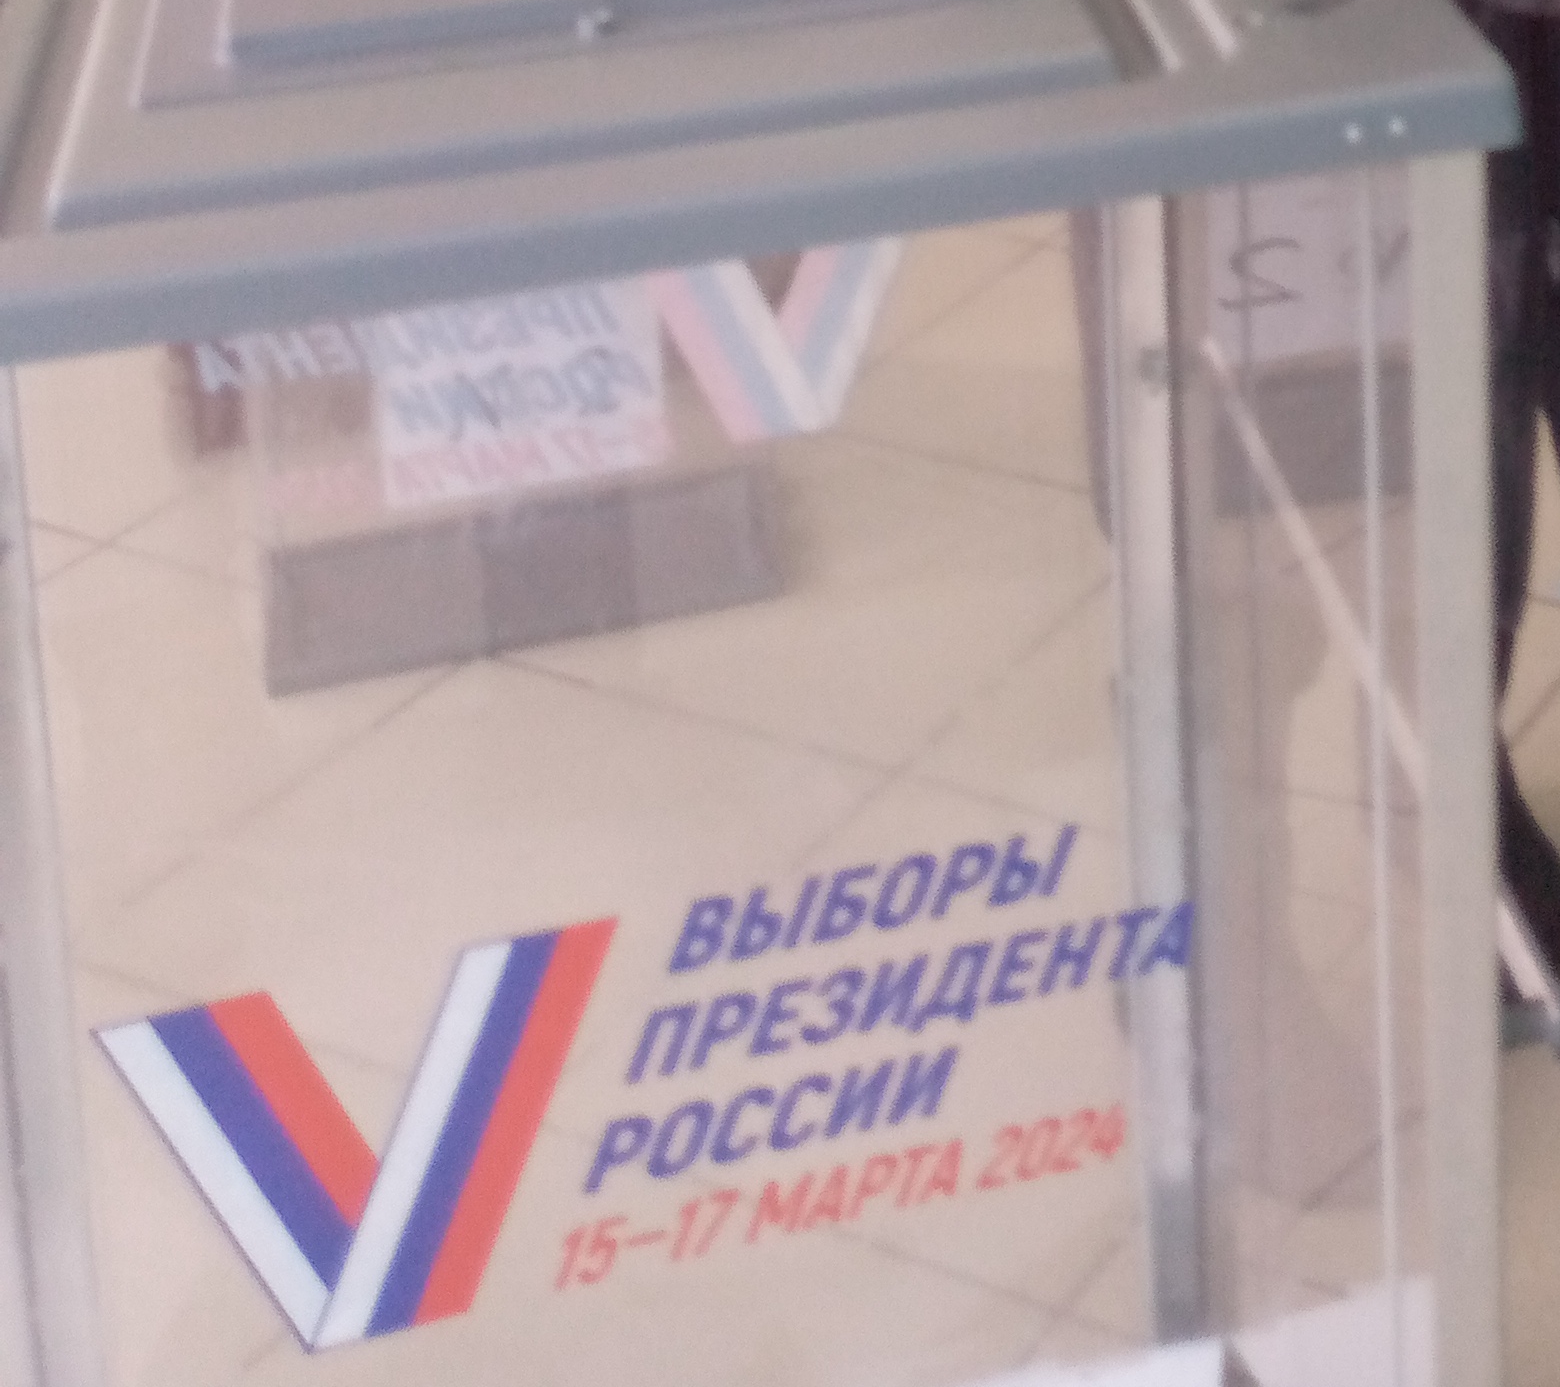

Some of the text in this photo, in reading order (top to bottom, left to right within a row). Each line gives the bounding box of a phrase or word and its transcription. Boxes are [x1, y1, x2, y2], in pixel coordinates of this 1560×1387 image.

[667, 823, 1078, 974] ВЫБОРЫ
[625, 901, 1195, 1085] ПРЕЗИДЕНТА
[582, 1047, 959, 1194] РОССИИ
[745, 1139, 964, 1245] МАРТА
[975, 1103, 1127, 1192] 2024
